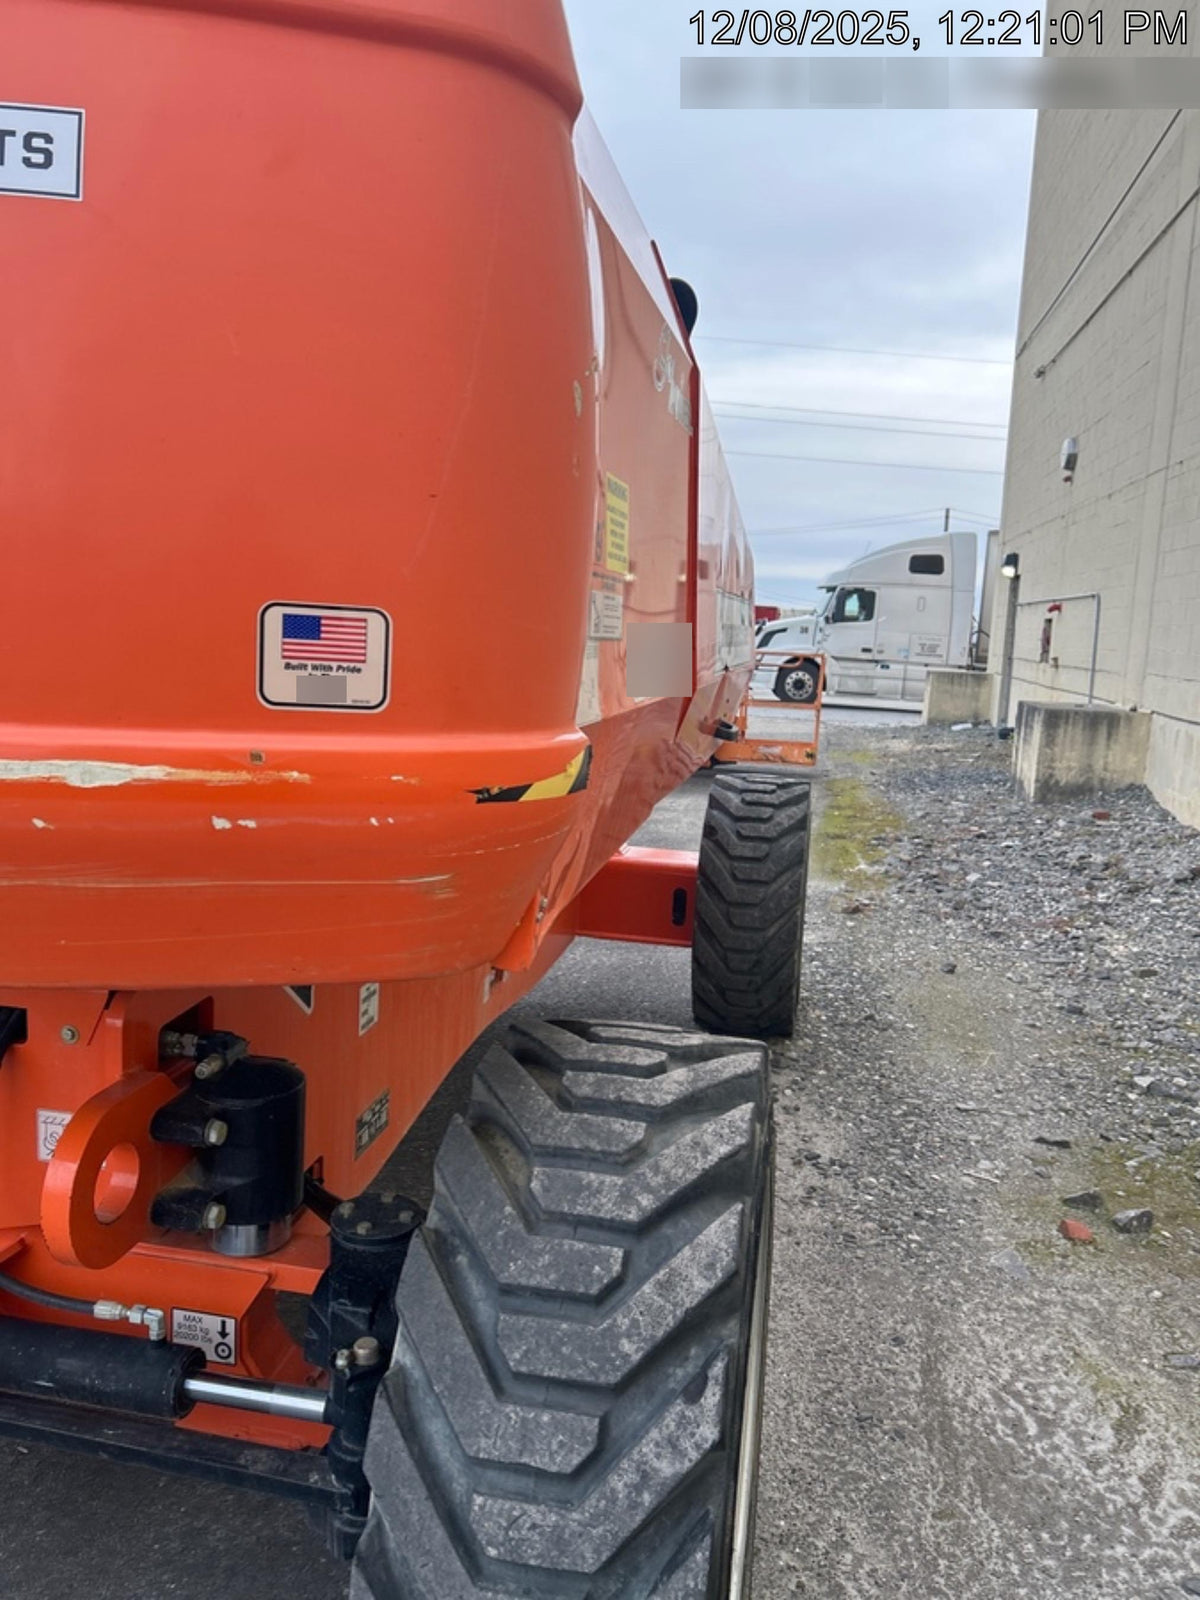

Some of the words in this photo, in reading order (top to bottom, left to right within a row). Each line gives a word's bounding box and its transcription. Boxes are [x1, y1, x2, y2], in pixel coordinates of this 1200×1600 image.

[284, 662, 309, 672] Built
[311, 663, 334, 673] With
[336, 665, 362, 674] Pride
[183, 1315, 203, 1324] MAX
[200, 1327, 209, 1336] kg
[201, 1334, 212, 1344] lbs
